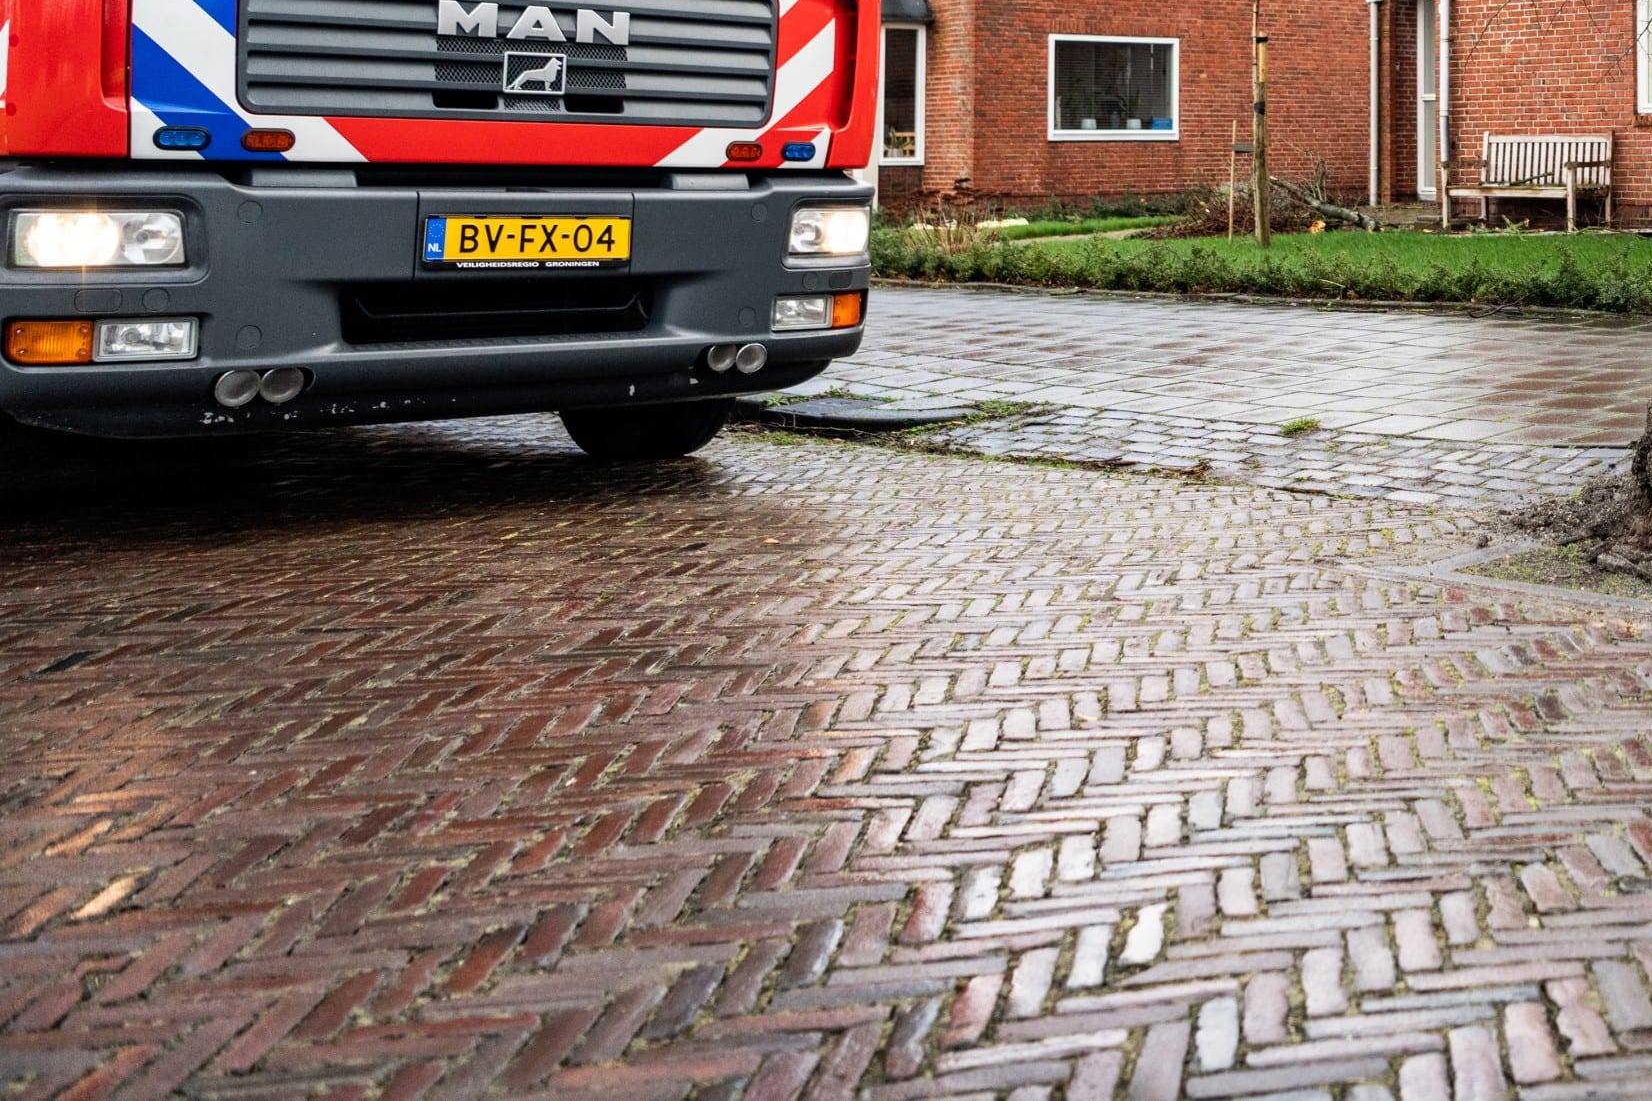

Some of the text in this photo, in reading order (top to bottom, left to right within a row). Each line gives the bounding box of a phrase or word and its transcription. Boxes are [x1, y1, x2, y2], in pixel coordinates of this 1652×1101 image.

[436, 0, 631, 46] MAN
[427, 242, 442, 253] NL
[458, 224, 616, 253] BV-FX-04
[455, 260, 540, 268] VEILIGHEIDSREGIO
